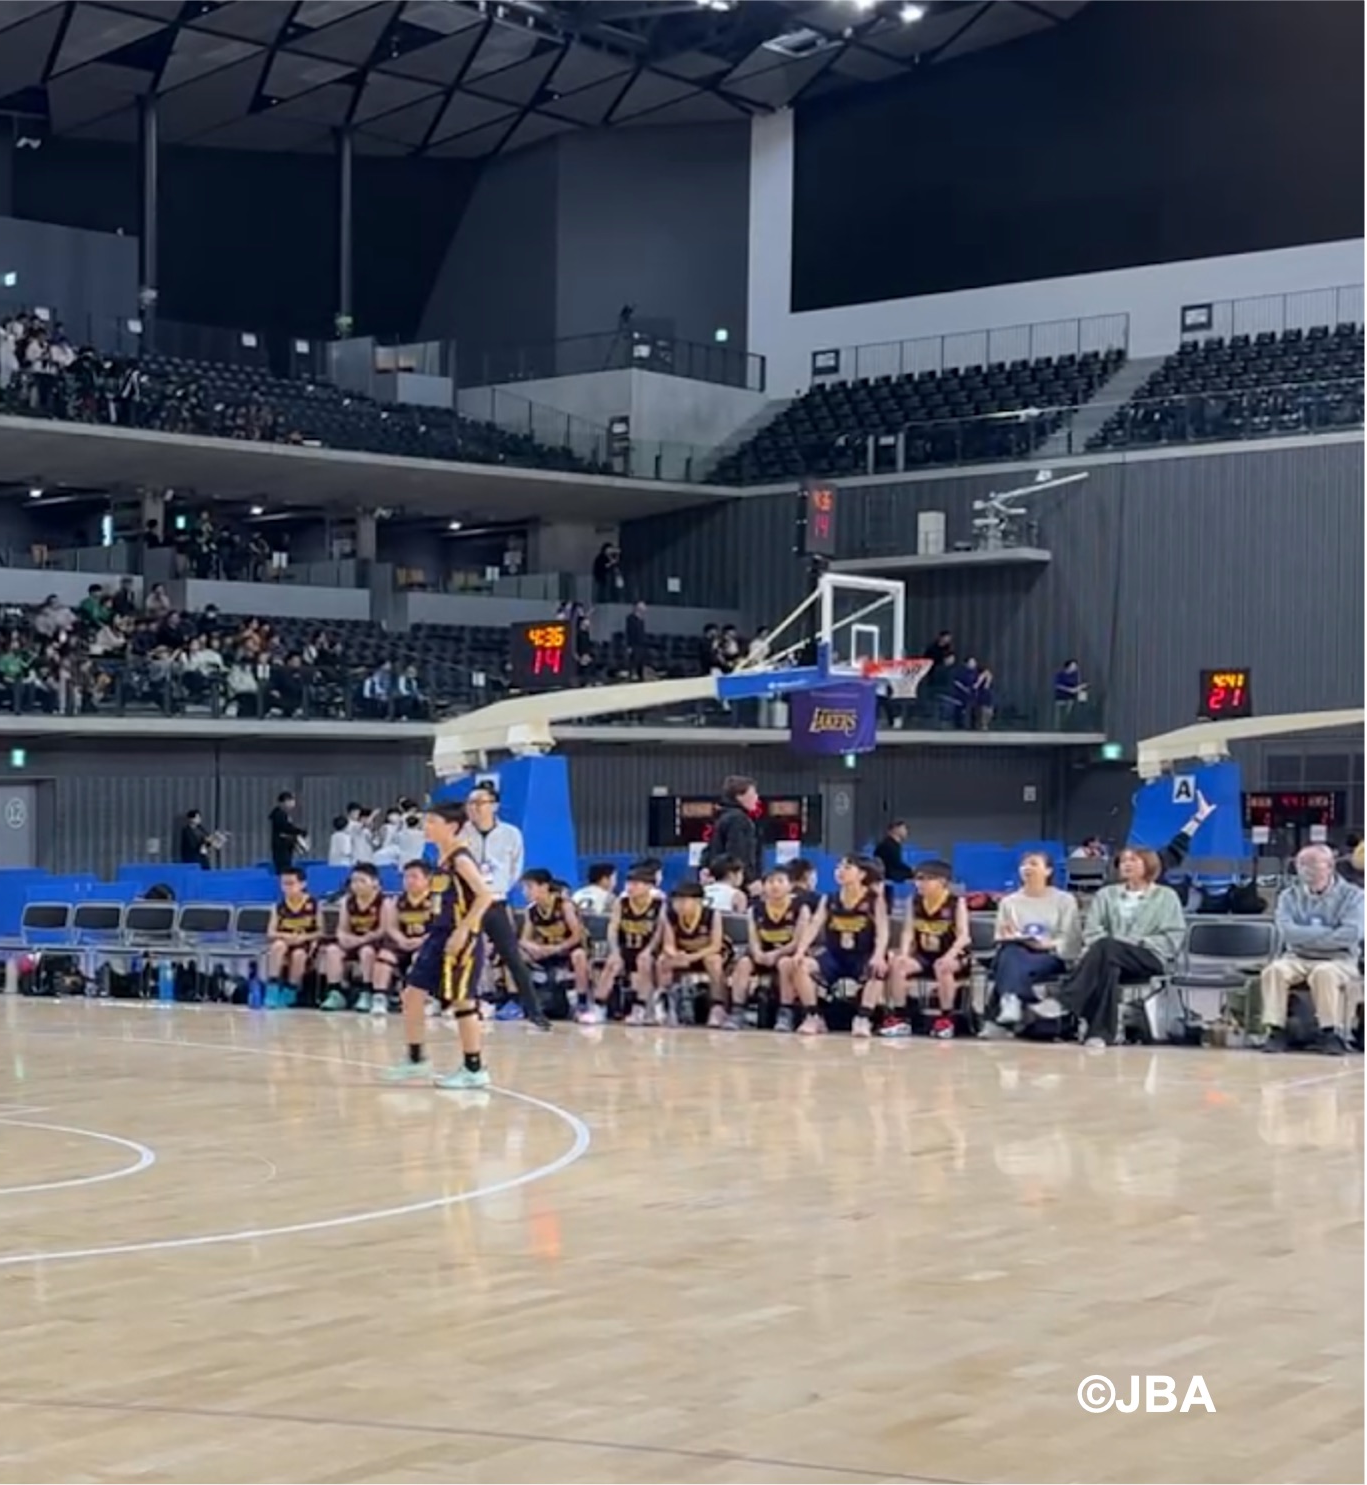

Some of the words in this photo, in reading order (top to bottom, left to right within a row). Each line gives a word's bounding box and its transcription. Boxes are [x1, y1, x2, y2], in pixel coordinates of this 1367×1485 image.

[534, 648, 561, 674] 14
[1208, 687, 1242, 710] 21
[1175, 780, 1192, 799] A
